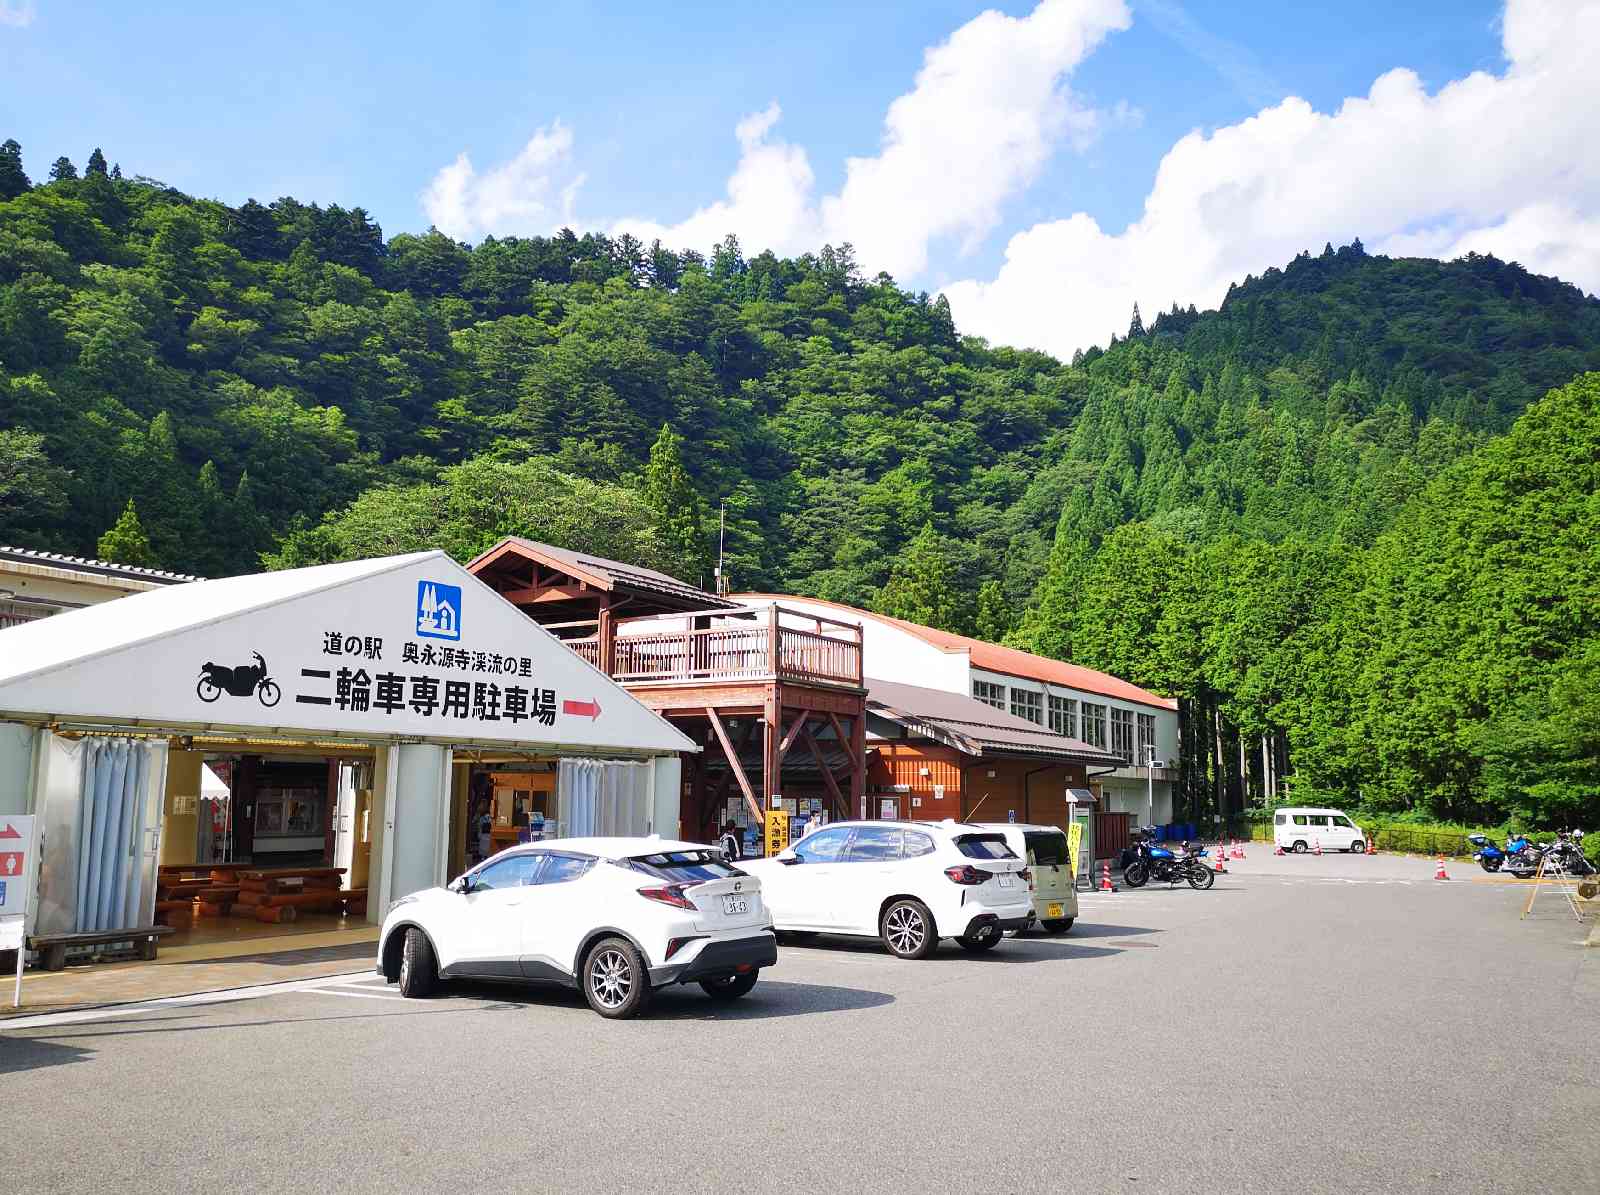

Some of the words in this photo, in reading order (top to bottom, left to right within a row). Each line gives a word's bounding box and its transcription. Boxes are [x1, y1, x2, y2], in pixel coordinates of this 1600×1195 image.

[323, 631, 383, 660] 道の駅
[402, 641, 533, 678] 奥永源寺渓流の里
[296, 666, 557, 726] 二輪車専用駐車場
